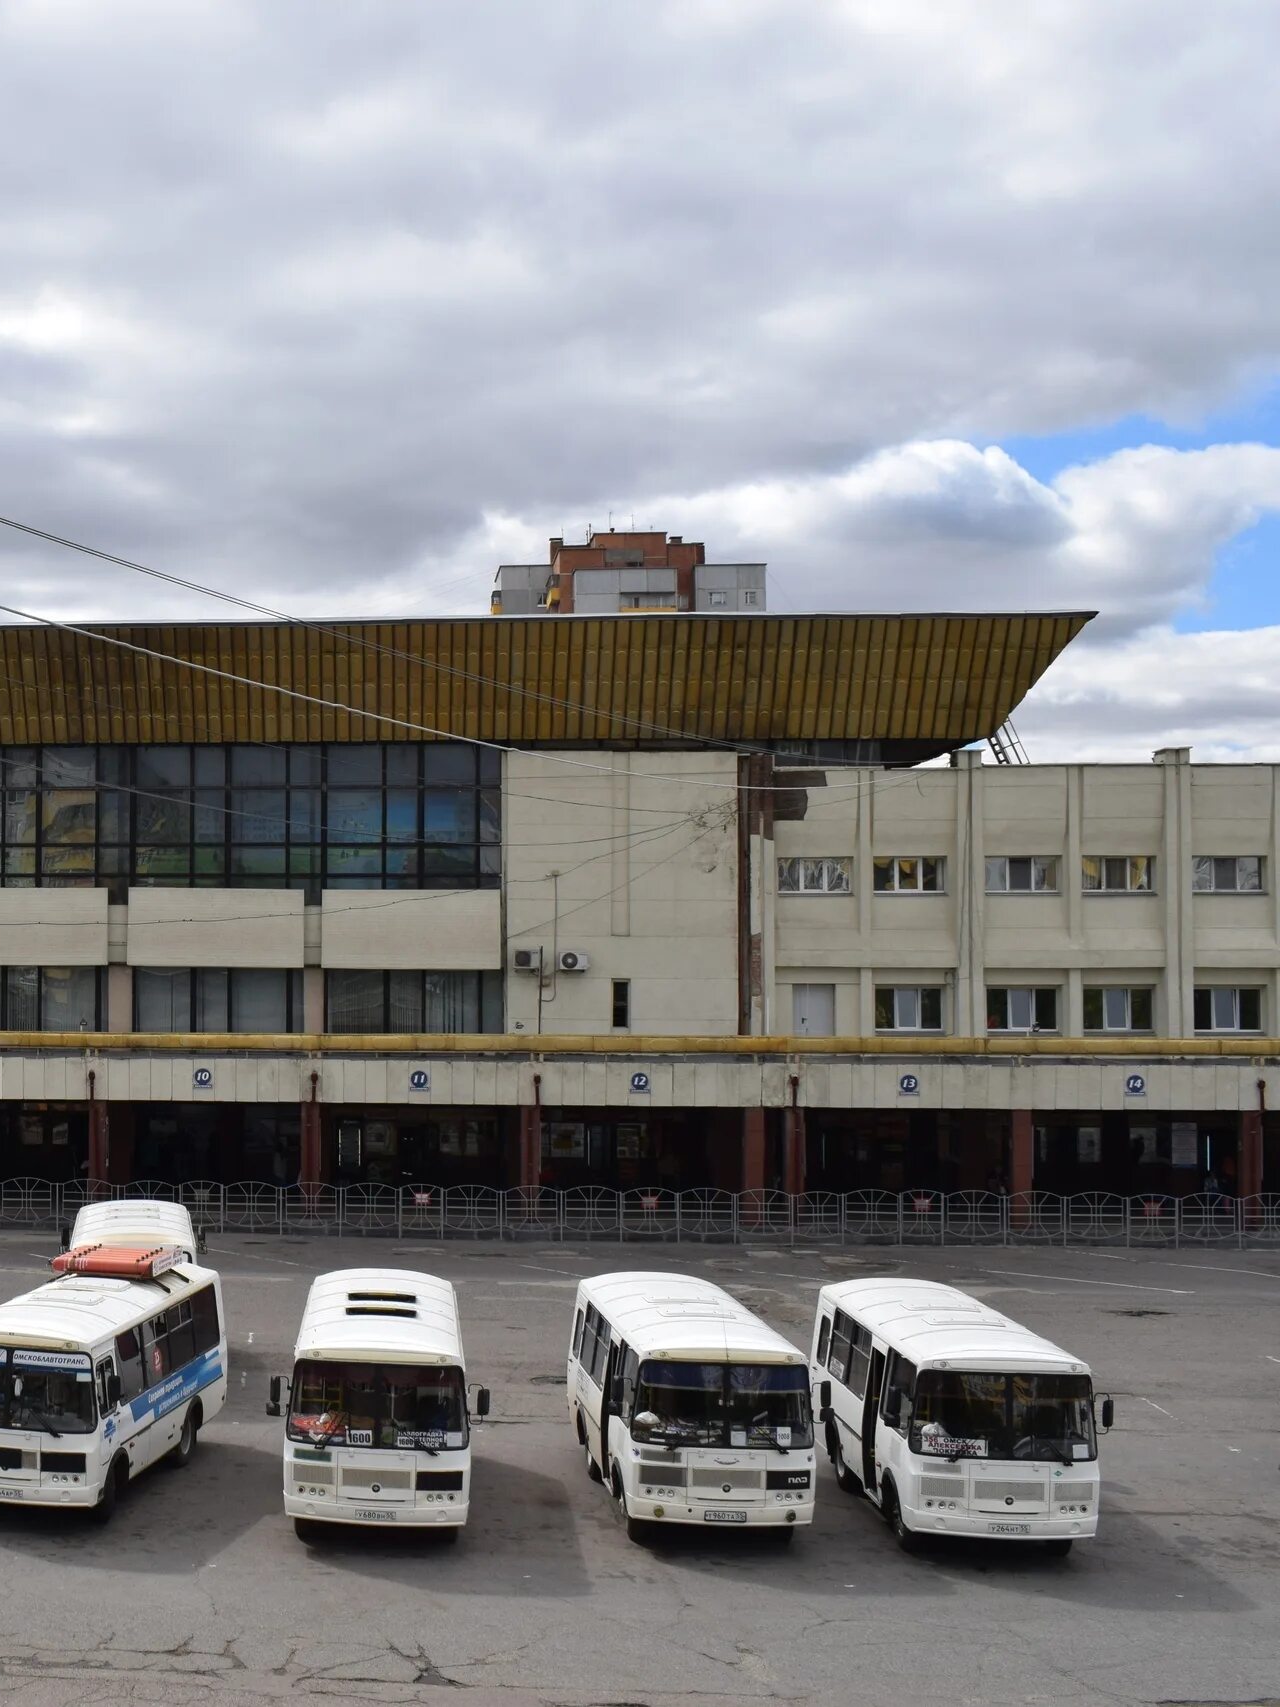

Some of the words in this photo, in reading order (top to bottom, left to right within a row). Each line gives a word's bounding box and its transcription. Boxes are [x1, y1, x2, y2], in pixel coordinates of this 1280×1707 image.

[197, 1072, 210, 1081] 10
[414, 1075, 425, 1083] 11
[634, 1077, 646, 1085] 12
[903, 1079, 916, 1088] 13
[1129, 1079, 1142, 1088] 14
[13, 1353, 86, 1365] ОМСКОБЛАВТОТРАНС
[348, 1432, 371, 1444] 1600
[398, 1438, 414, 1446] 1600
